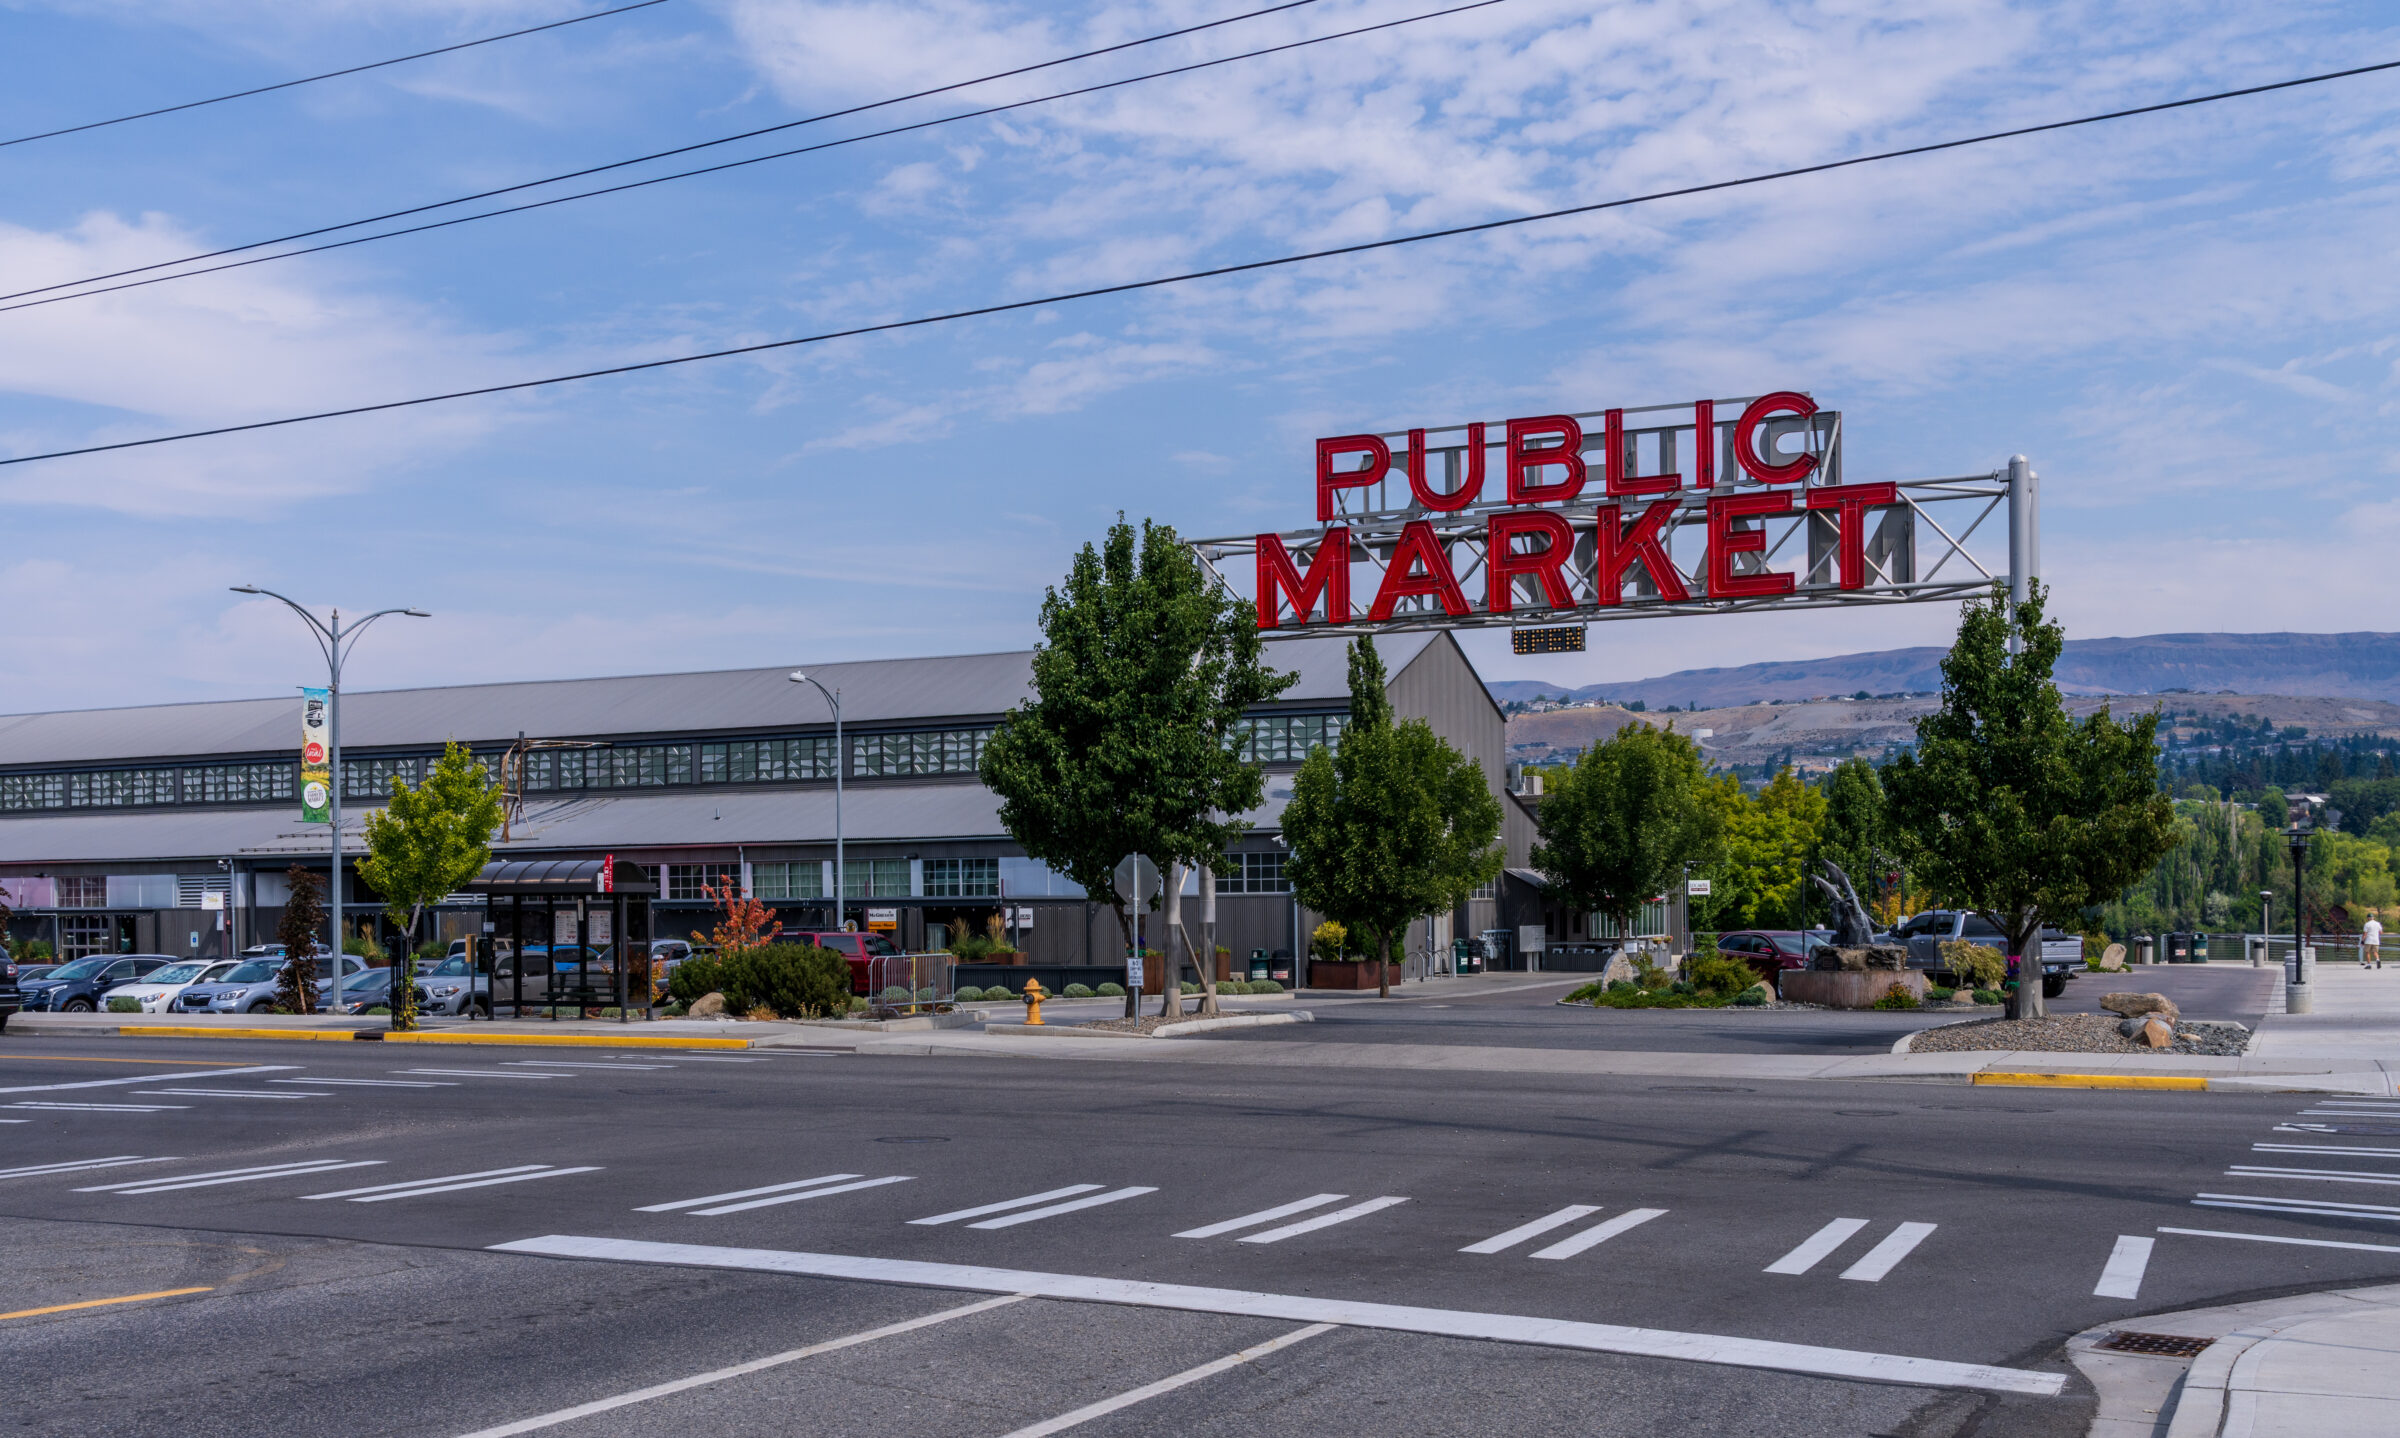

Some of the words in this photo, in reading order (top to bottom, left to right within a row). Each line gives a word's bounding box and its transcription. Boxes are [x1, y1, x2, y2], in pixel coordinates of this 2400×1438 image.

[1316, 391, 1819, 521] PUBLIC
[1256, 481, 1896, 628] MARKET
[1514, 627, 1581, 653] OPEN
